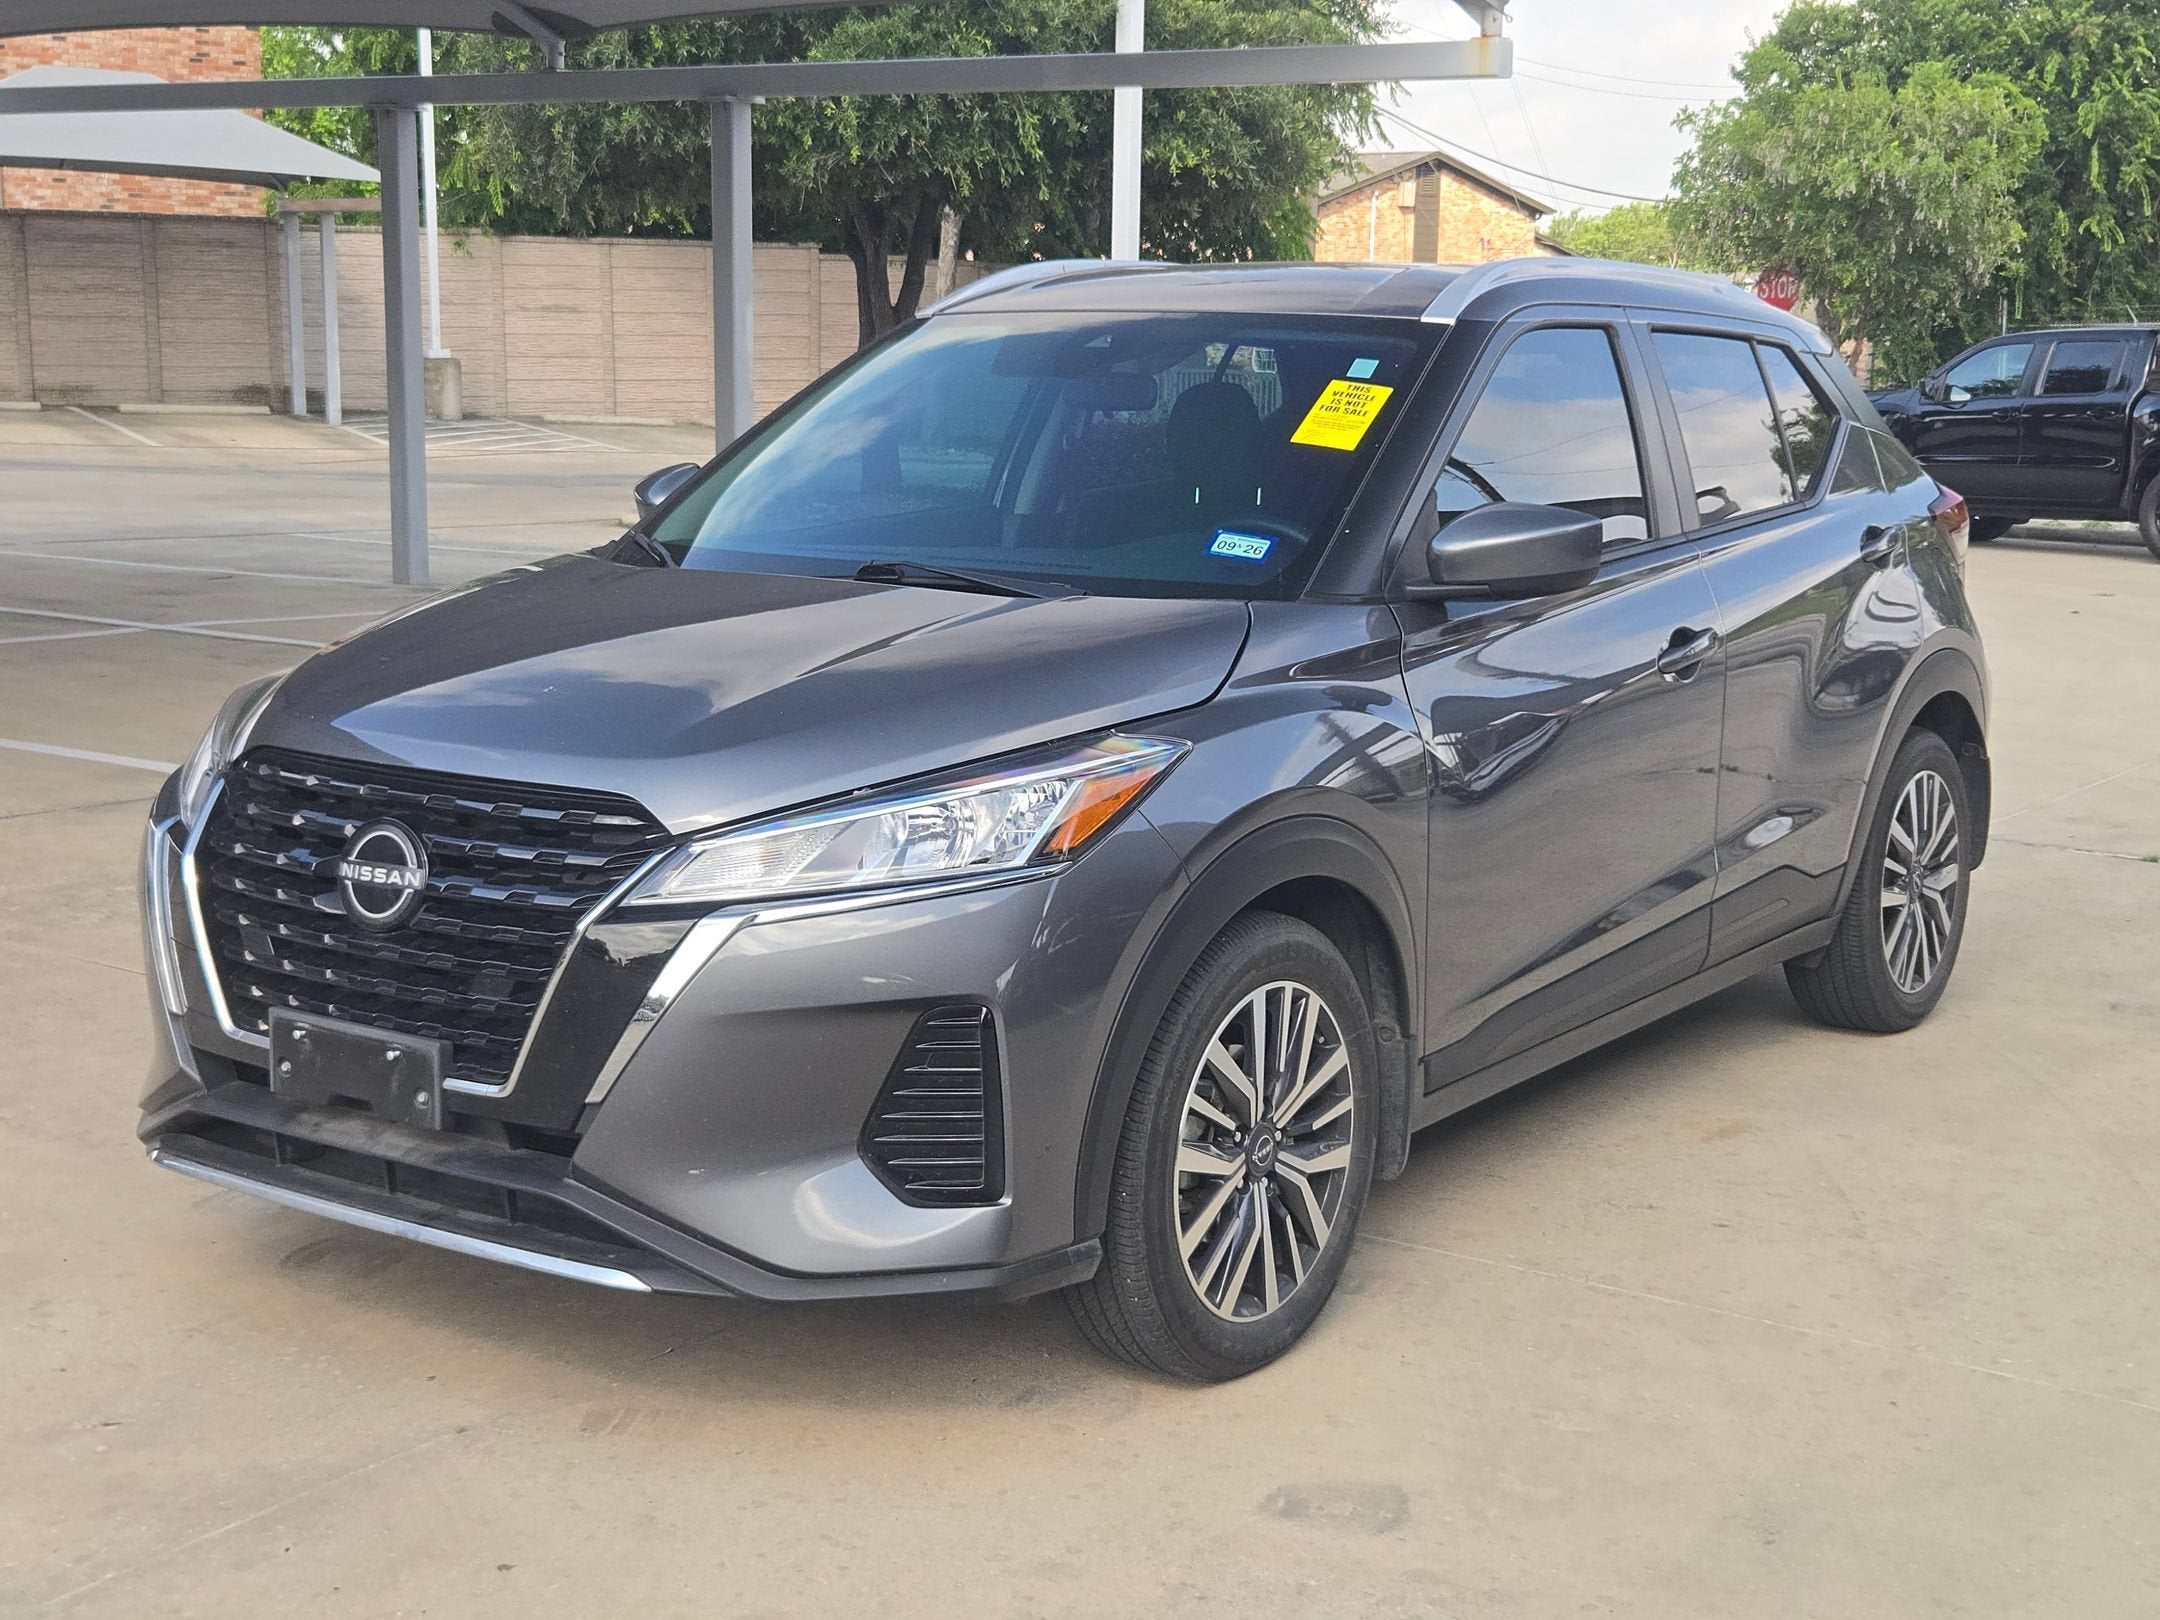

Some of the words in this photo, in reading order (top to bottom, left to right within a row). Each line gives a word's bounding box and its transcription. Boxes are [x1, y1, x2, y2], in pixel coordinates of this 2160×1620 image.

[1346, 384, 1373, 394] THIS
[1331, 390, 1376, 402] VEHICLE
[1344, 400, 1367, 409] NOT
[1319, 405, 1340, 413] FOR
[1342, 407, 1369, 417] SALE
[1216, 540, 1237, 551] 09
[1242, 544, 1264, 556] 26
[341, 862, 421, 887] NISSAN
